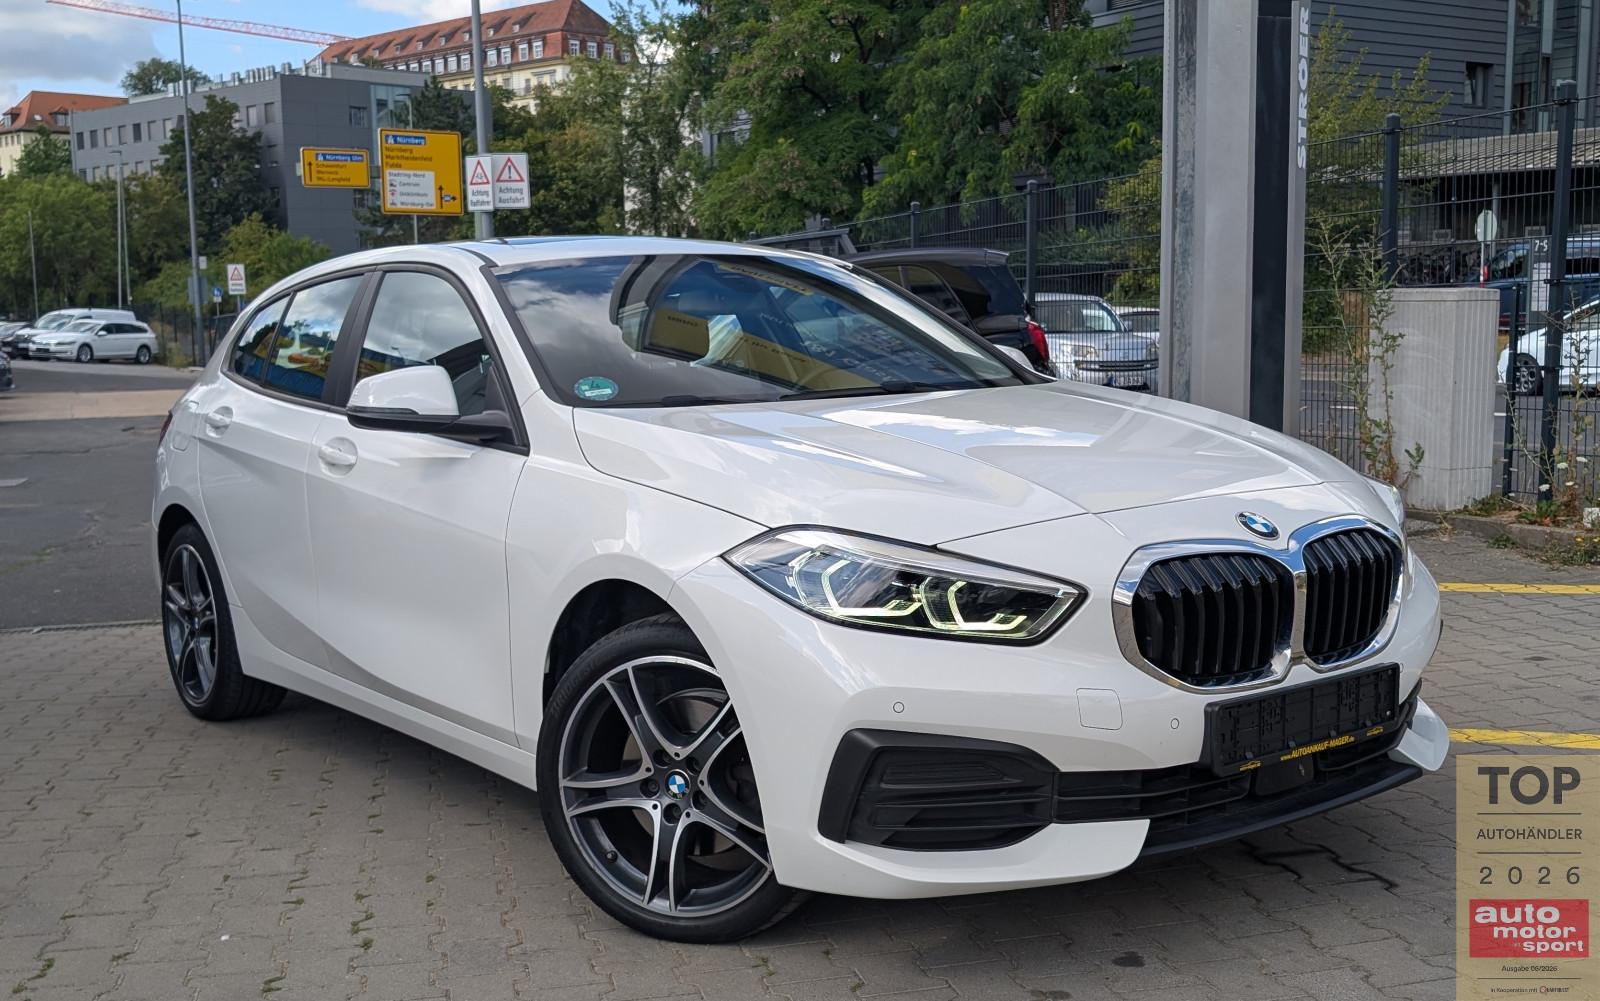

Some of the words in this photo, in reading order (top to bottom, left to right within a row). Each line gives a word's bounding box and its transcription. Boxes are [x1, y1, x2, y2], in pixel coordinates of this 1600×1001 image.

[396, 136, 426, 146] Nürnberg
[385, 146, 413, 155] Nürnberg
[499, 186, 524, 195] Achtung
[498, 196, 525, 204] Ausfahrt
